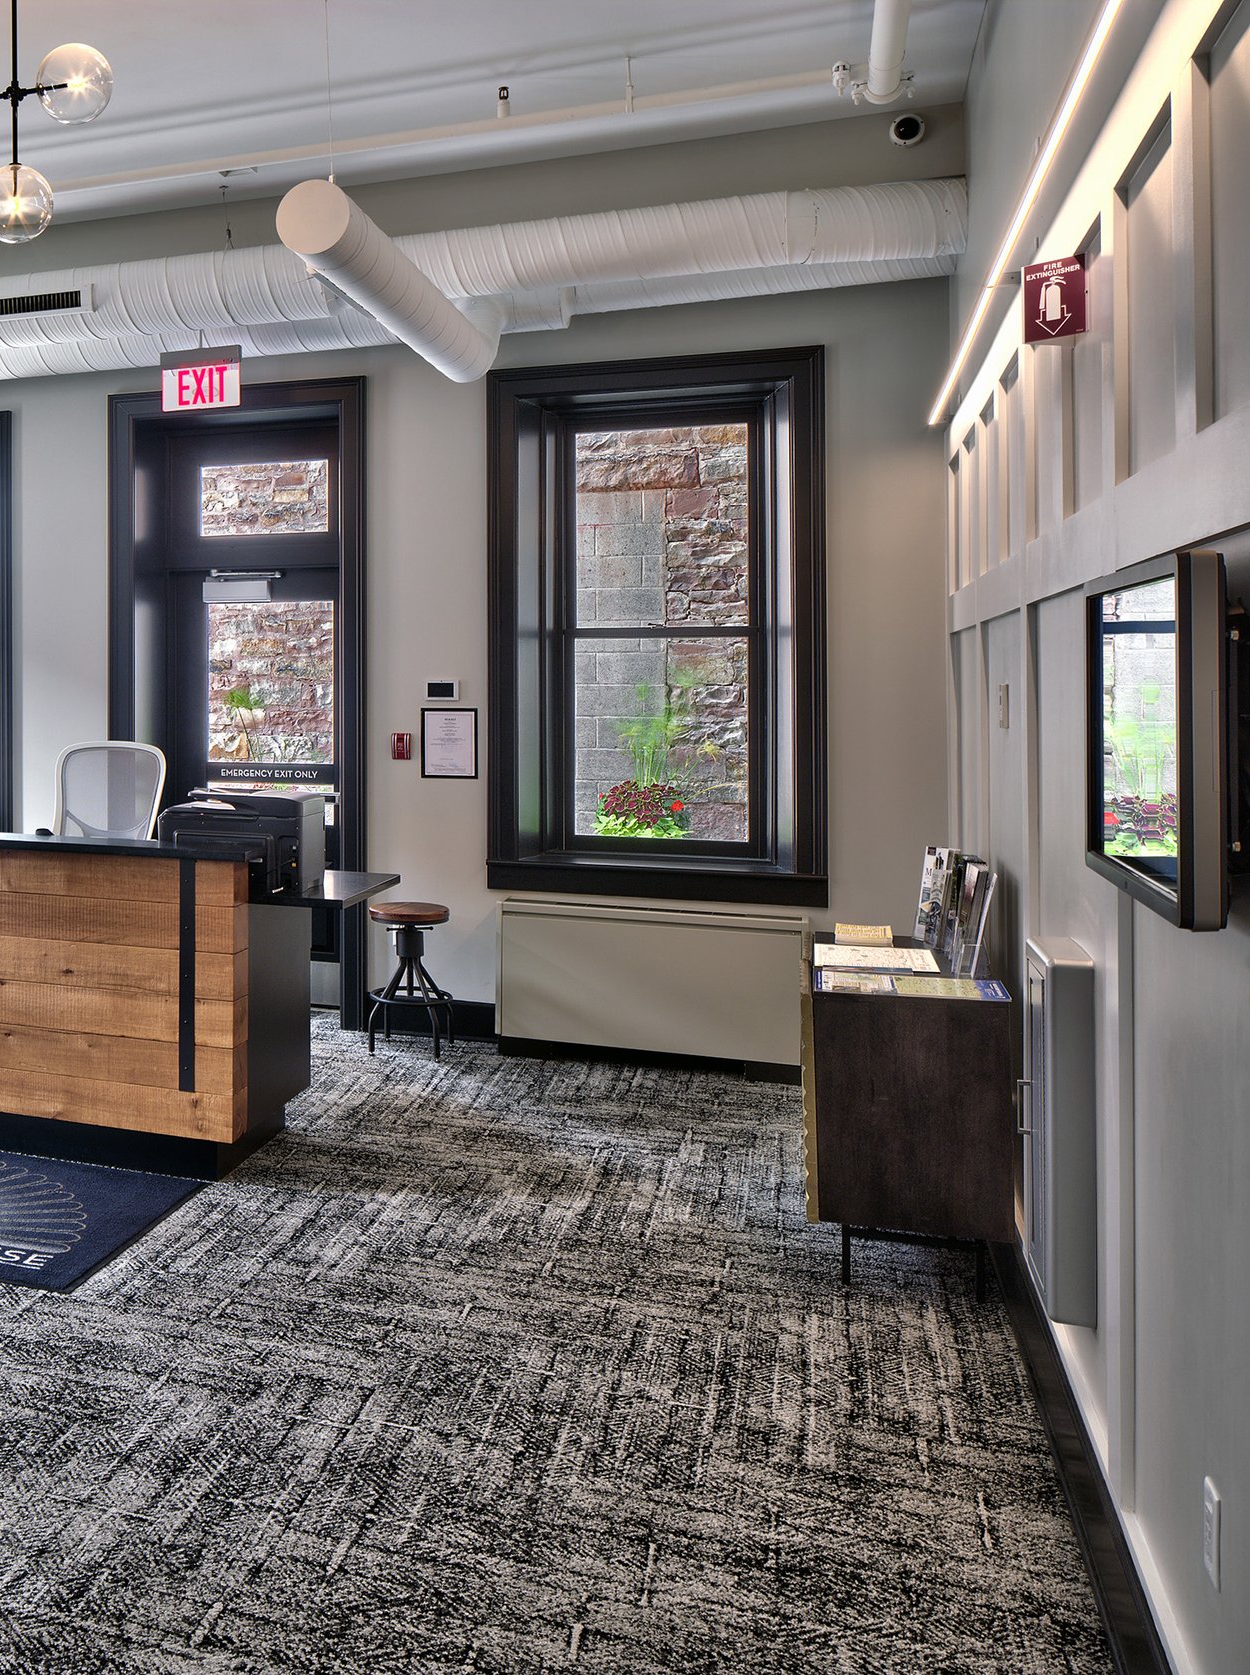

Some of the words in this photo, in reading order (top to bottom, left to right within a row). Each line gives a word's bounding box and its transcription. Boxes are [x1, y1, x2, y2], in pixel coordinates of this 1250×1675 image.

[1025, 264, 1081, 281] EXTINGUISHER
[1043, 261, 1063, 271] FIRE
[177, 366, 228, 407] EXIT
[220, 768, 273, 778] EMERGENCY
[274, 770, 293, 779] EXIT
[294, 770, 318, 779] ONLY
